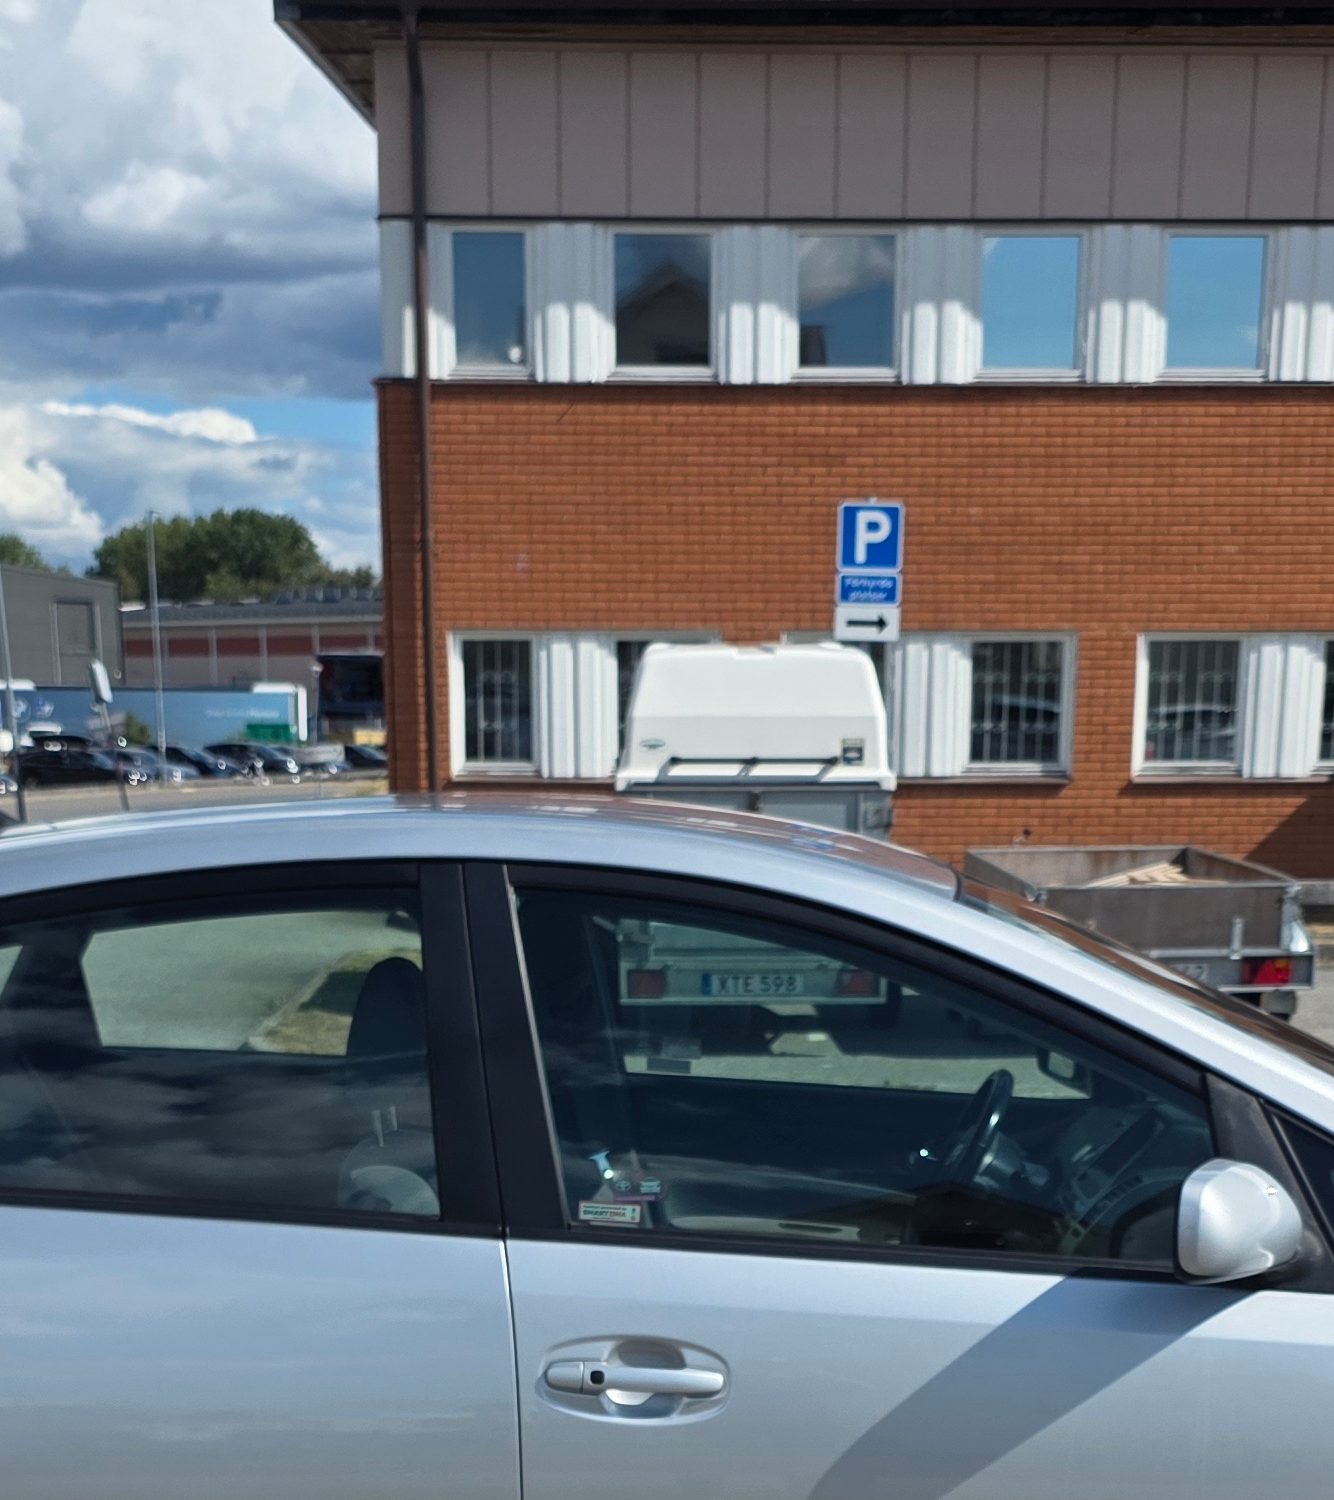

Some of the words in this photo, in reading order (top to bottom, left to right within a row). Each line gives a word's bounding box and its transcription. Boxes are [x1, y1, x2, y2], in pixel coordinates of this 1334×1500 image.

[854, 509, 893, 565] P
[716, 975, 754, 994] XTE
[759, 975, 797, 993] 598
